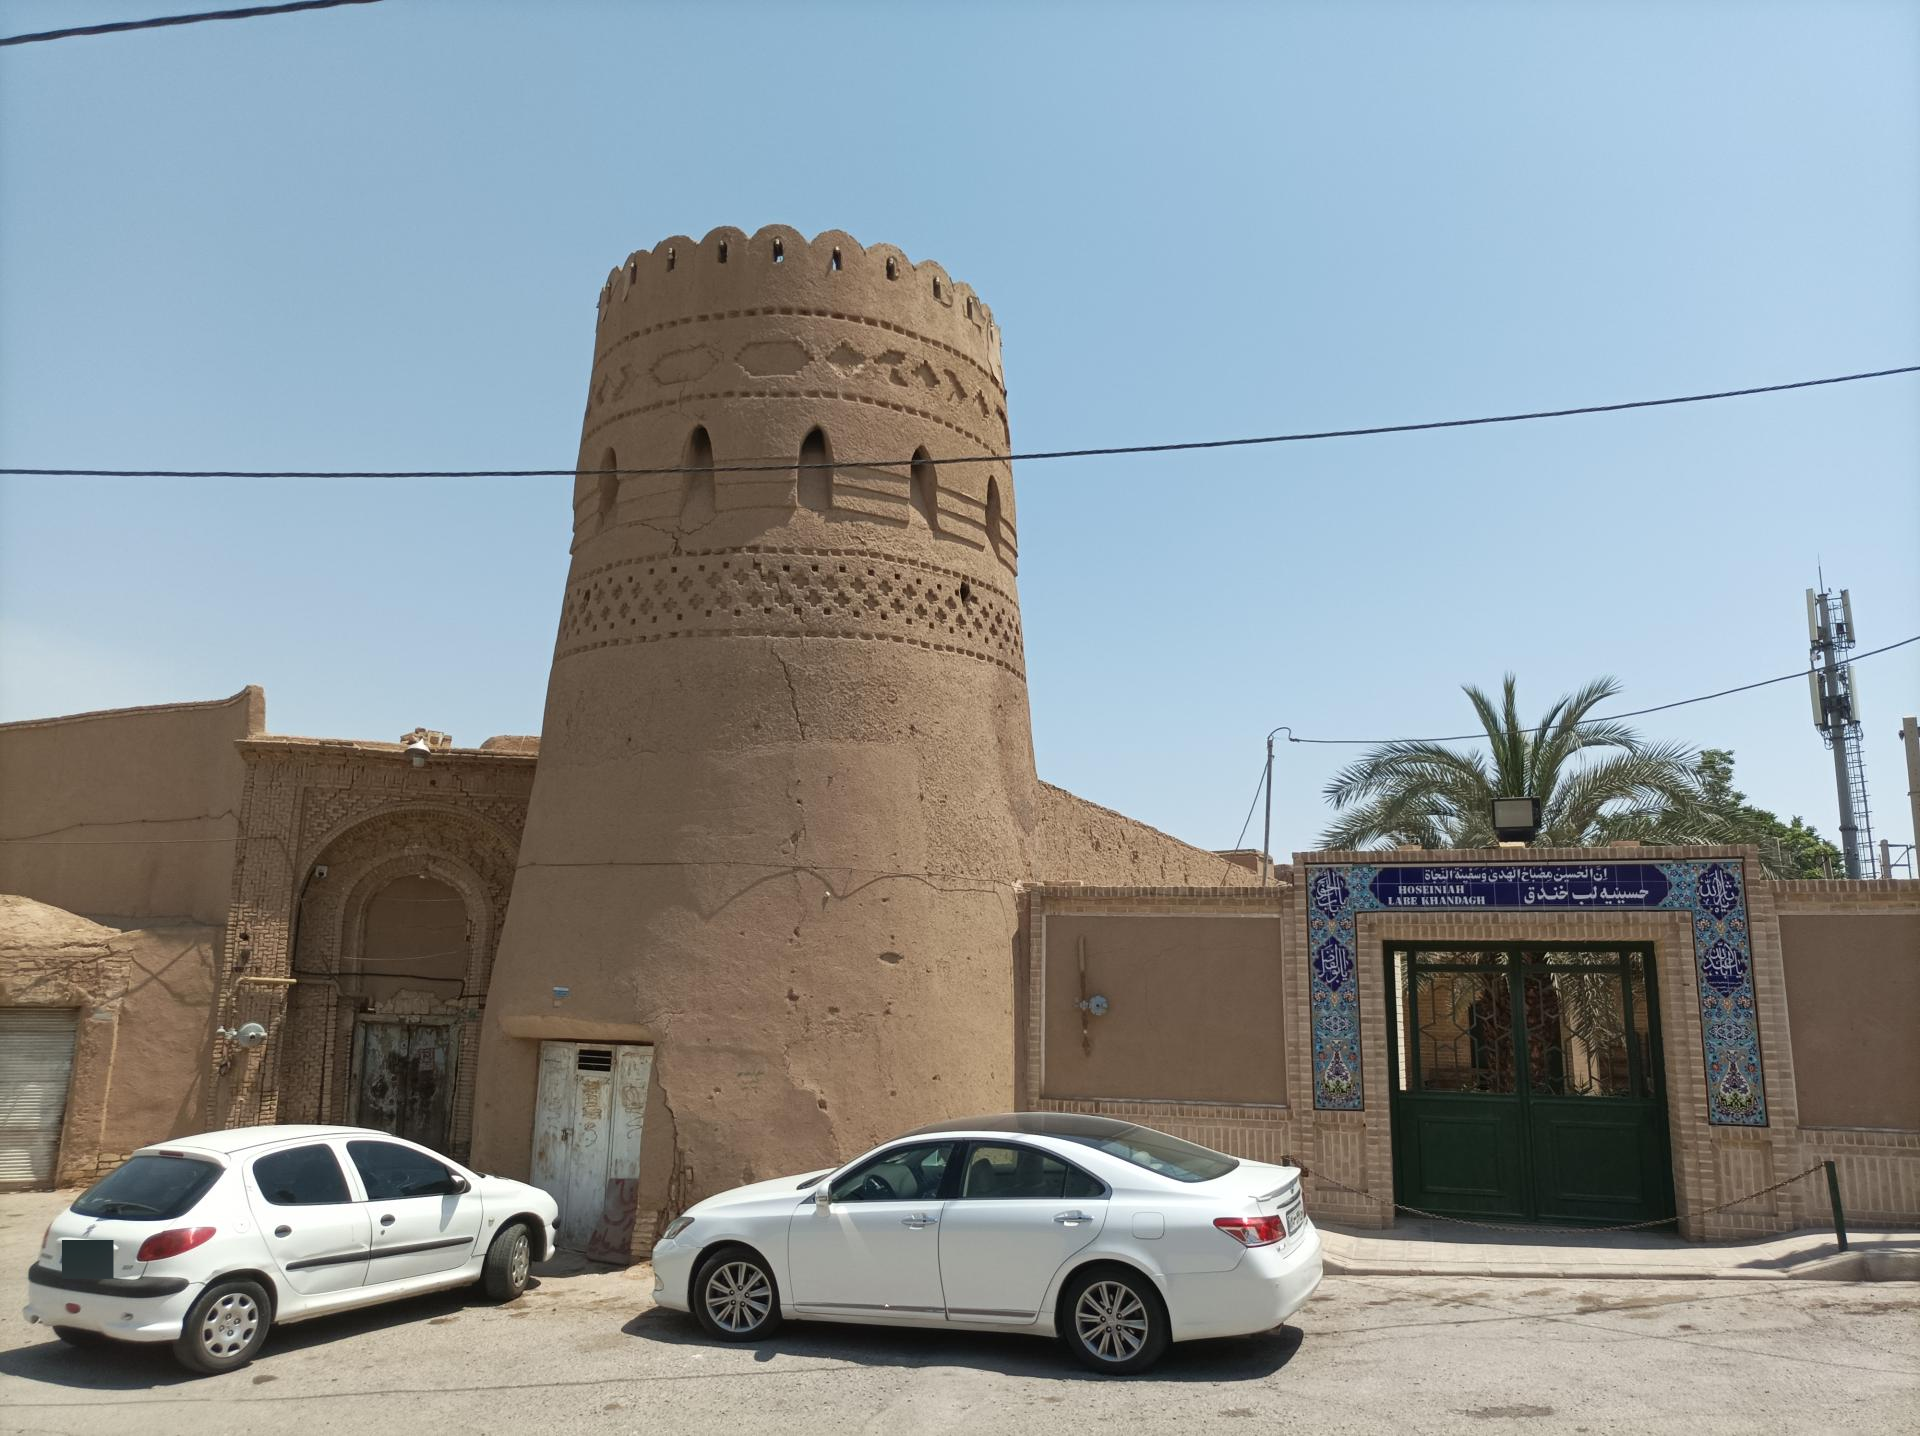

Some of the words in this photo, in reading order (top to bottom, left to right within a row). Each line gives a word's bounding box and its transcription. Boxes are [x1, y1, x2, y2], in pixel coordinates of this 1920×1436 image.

[1398, 884, 1465, 895] HOSEINIAH
[1523, 884, 1569, 905] خندق
[1571, 885, 1598, 906] لب
[1599, 886, 1649, 905] حسینیه
[1388, 896, 1418, 906] LABE
[1420, 895, 1486, 906] KHANDAGH
